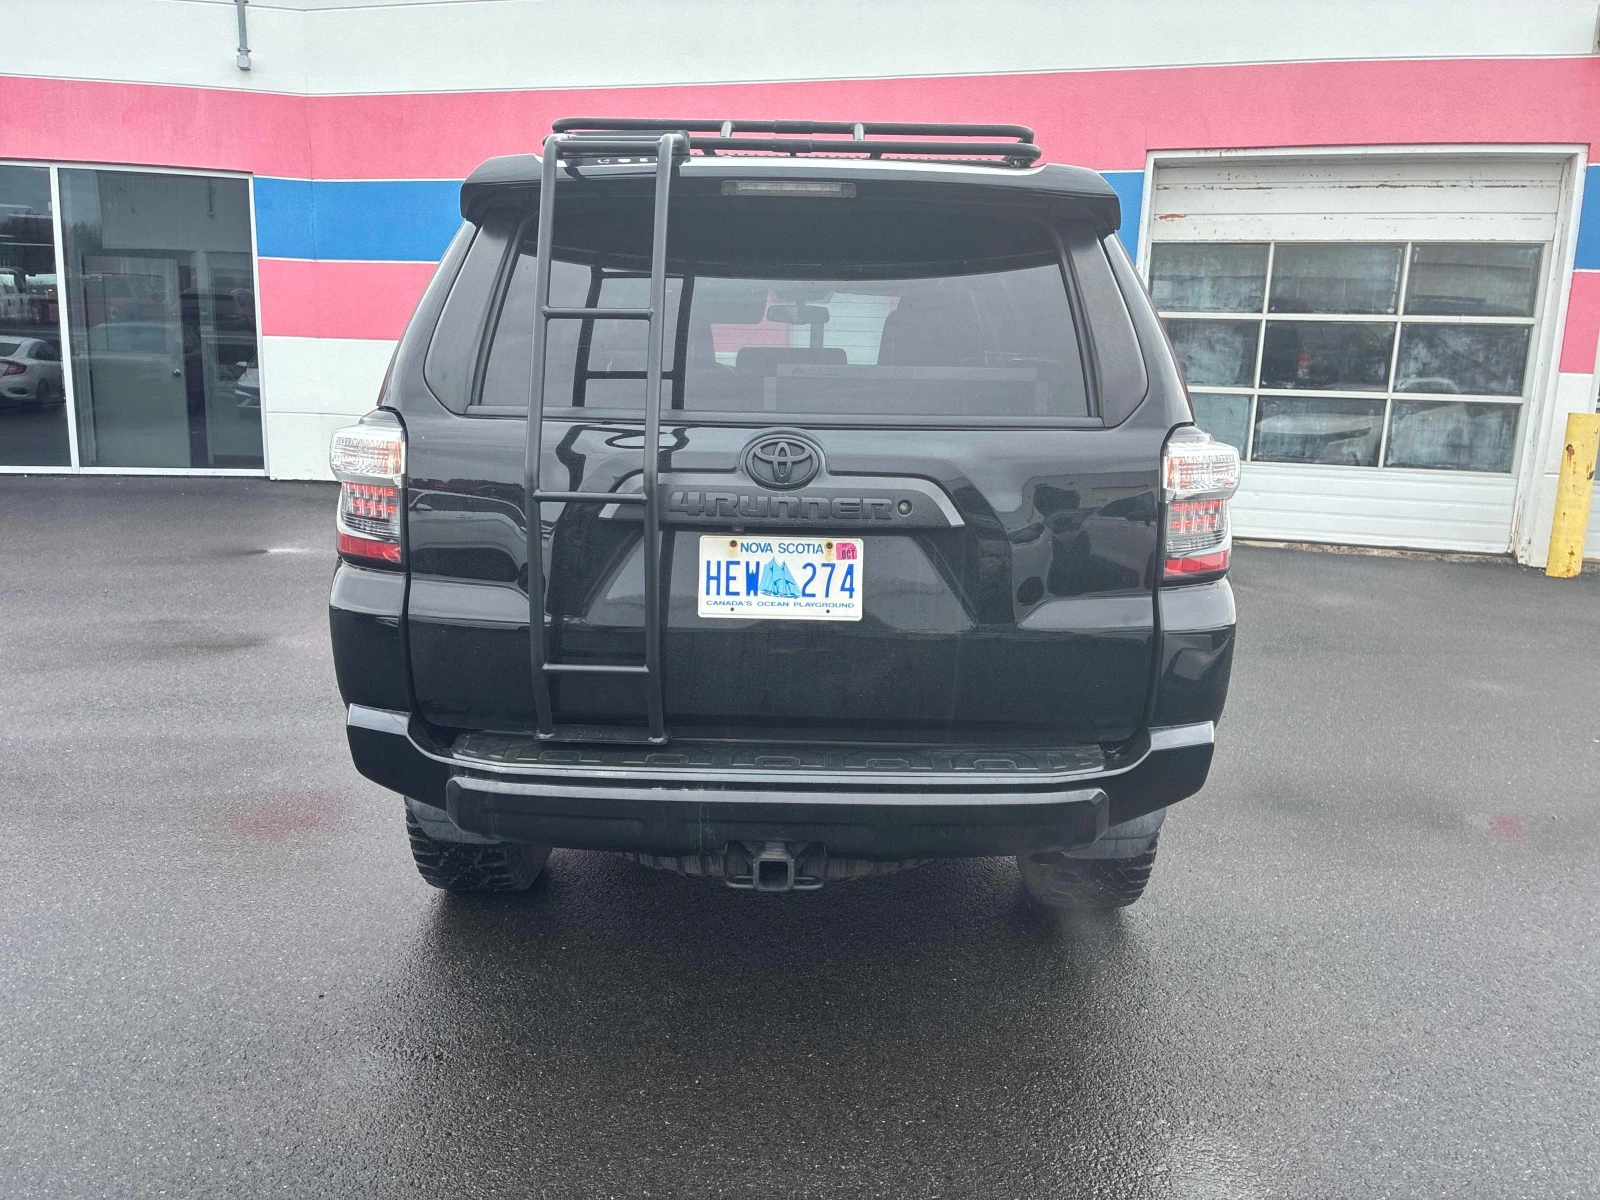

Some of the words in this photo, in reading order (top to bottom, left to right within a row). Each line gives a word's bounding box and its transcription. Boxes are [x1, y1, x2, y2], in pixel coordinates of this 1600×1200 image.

[740, 542, 773, 553] NOVA
[778, 543, 824, 554] SCOTIA
[841, 549, 856, 560] OCT
[705, 560, 761, 596] HEW
[801, 562, 855, 599] 274
